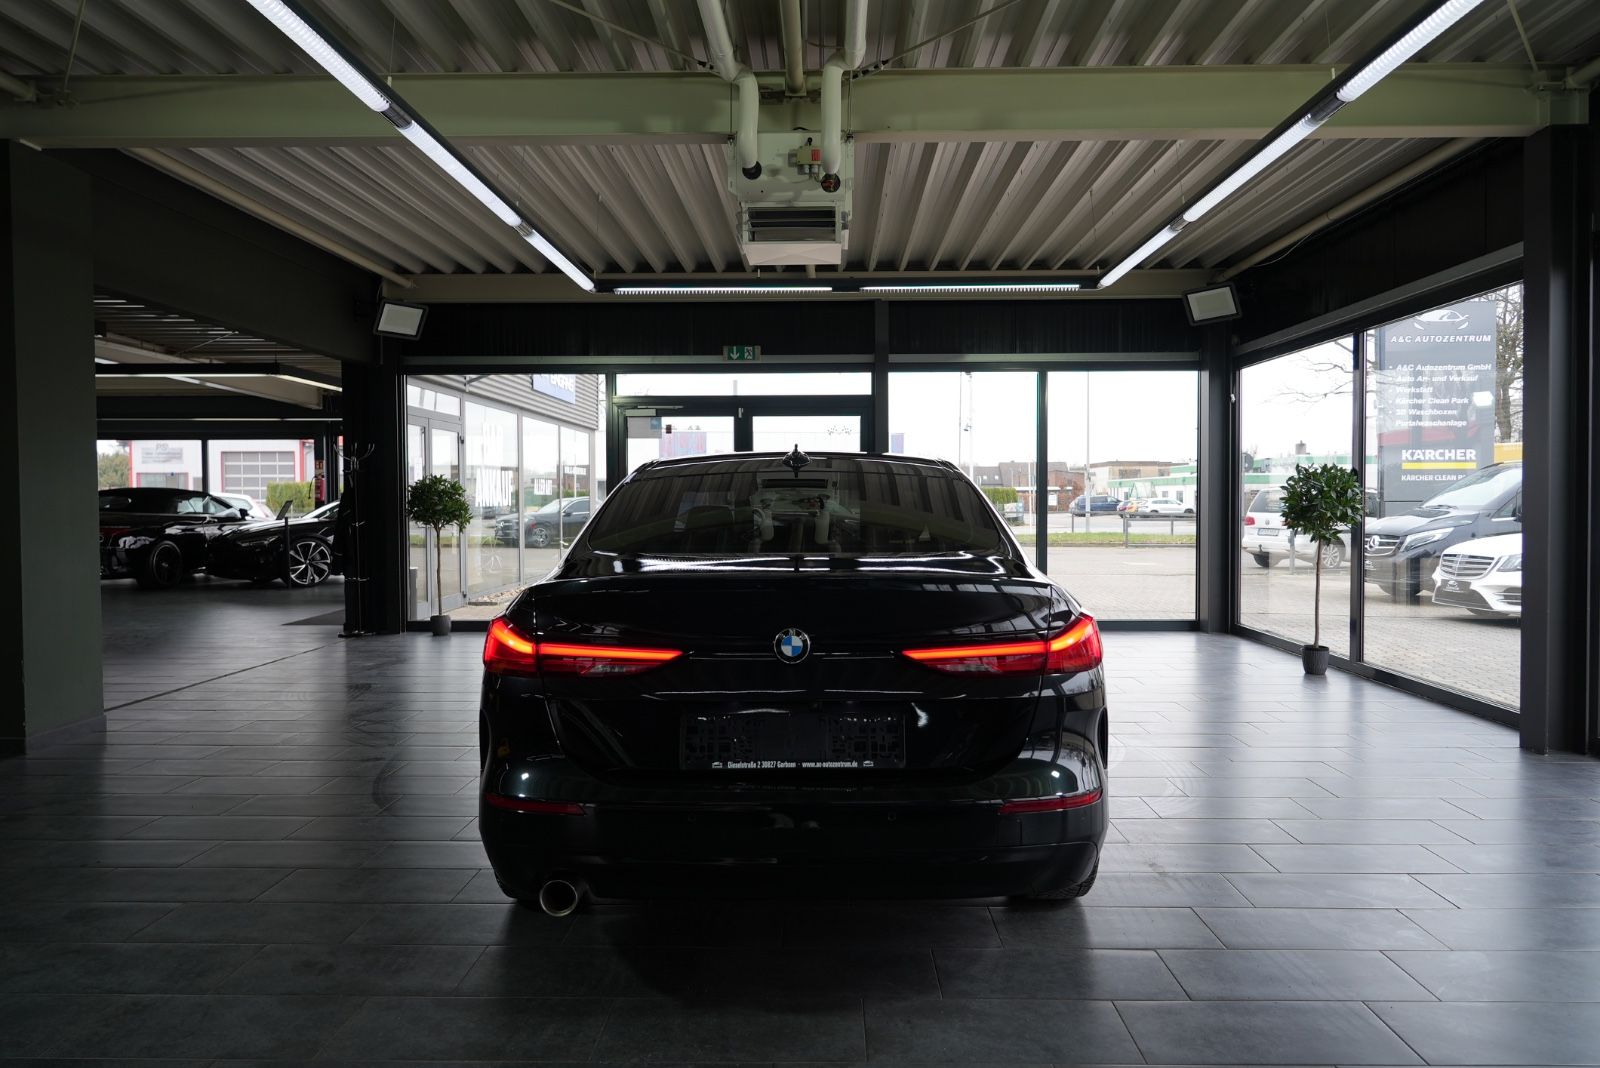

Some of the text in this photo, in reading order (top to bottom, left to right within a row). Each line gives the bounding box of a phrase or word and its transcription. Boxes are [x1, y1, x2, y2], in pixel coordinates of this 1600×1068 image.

[1390, 334, 1492, 343] A&C AUTOZENTRUM
[1467, 363, 1492, 371] GmbH
[1395, 419, 1467, 428] Portalwaschanlage
[1401, 449, 1476, 461] KÄRCHER
